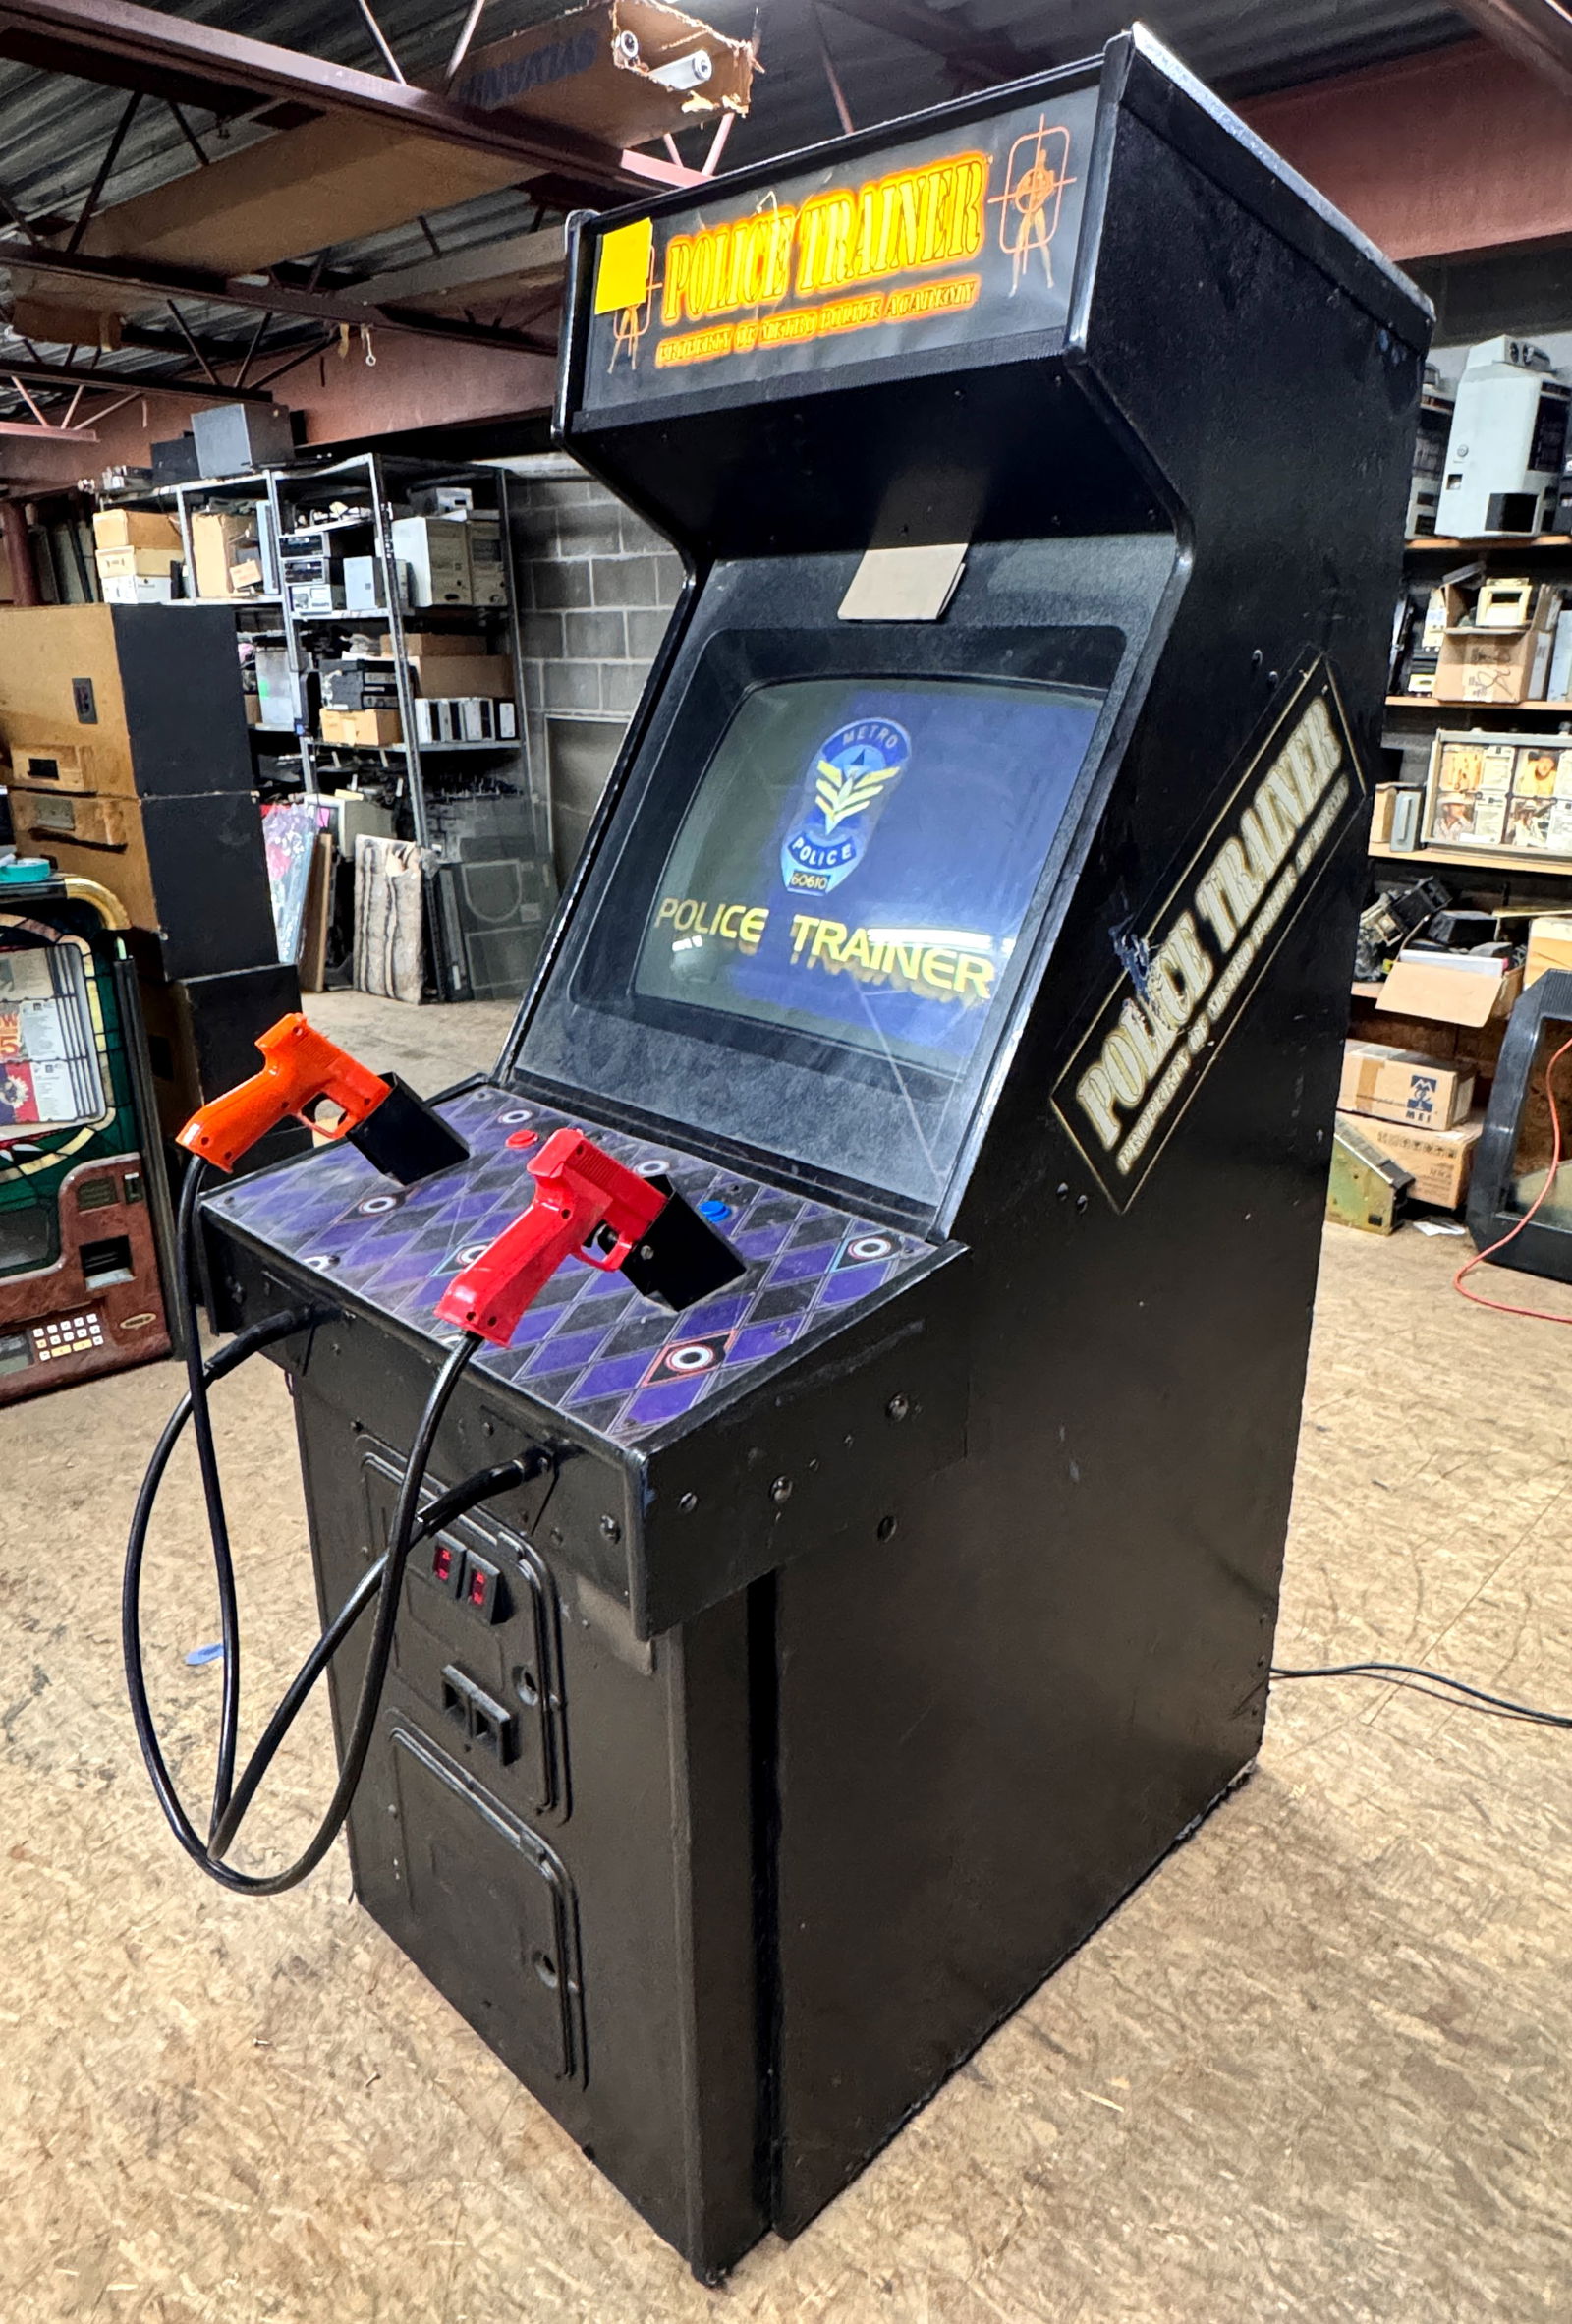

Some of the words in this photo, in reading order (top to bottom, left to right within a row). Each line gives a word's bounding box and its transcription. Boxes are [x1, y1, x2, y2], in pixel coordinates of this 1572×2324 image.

[664, 212, 795, 320] POLICE
[795, 158, 985, 290] TRAINER
[841, 724, 899, 749] METRO
[791, 836, 853, 867] POLICE
[790, 872, 829, 890] 60610
[1077, 909, 1213, 1151] POLICE
[1195, 696, 1342, 954] TRAINER
[654, 897, 770, 945] POLICE
[790, 913, 995, 1001] TRAINER
[1406, 1109, 1432, 1124] MEI
